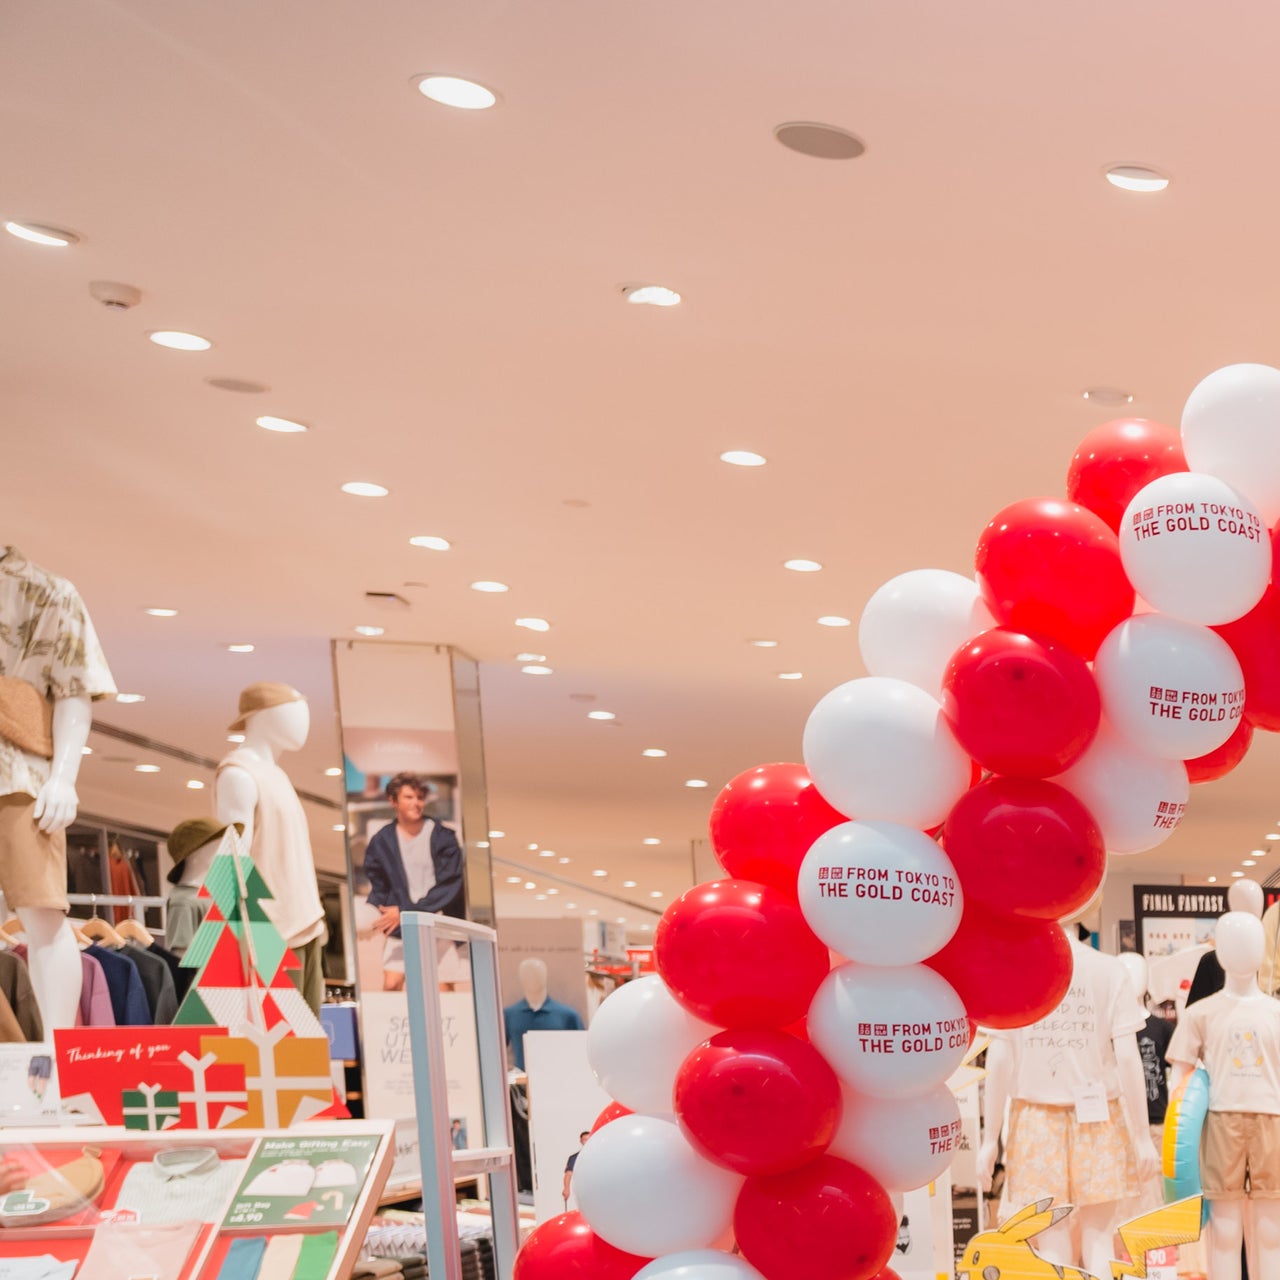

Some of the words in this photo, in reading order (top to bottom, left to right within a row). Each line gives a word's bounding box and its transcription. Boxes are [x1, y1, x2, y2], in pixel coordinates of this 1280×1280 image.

[1157, 503, 1195, 518] FROM
[1201, 503, 1243, 520] TOKYO
[1247, 511, 1260, 527] TO
[1134, 521, 1160, 541] THE
[1166, 517, 1210, 532] GOLD
[1218, 519, 1261, 543] COAST
[1182, 691, 1217, 706] FROM
[1149, 702, 1181, 719] THE
[1188, 707, 1225, 722] GOLD
[1153, 814, 1173, 829] THE
[847, 867, 889, 881] FROM
[895, 870, 939, 887] TOKYO
[943, 876, 954, 890] TO
[818, 883, 848, 897] THE
[856, 884, 902, 901] GOLD
[911, 887, 954, 908] COAST
[1142, 894, 1175, 912] FINAL
[892, 1023, 931, 1037] FROM
[936, 1018, 965, 1034] TOKYO
[67, 1047, 125, 1064] Thinking
[129, 1043, 143, 1060] of
[148, 1044, 171, 1058] you
[859, 1038, 894, 1053] THE
[901, 1037, 944, 1053] GOLD
[930, 1138, 952, 1154] THE
